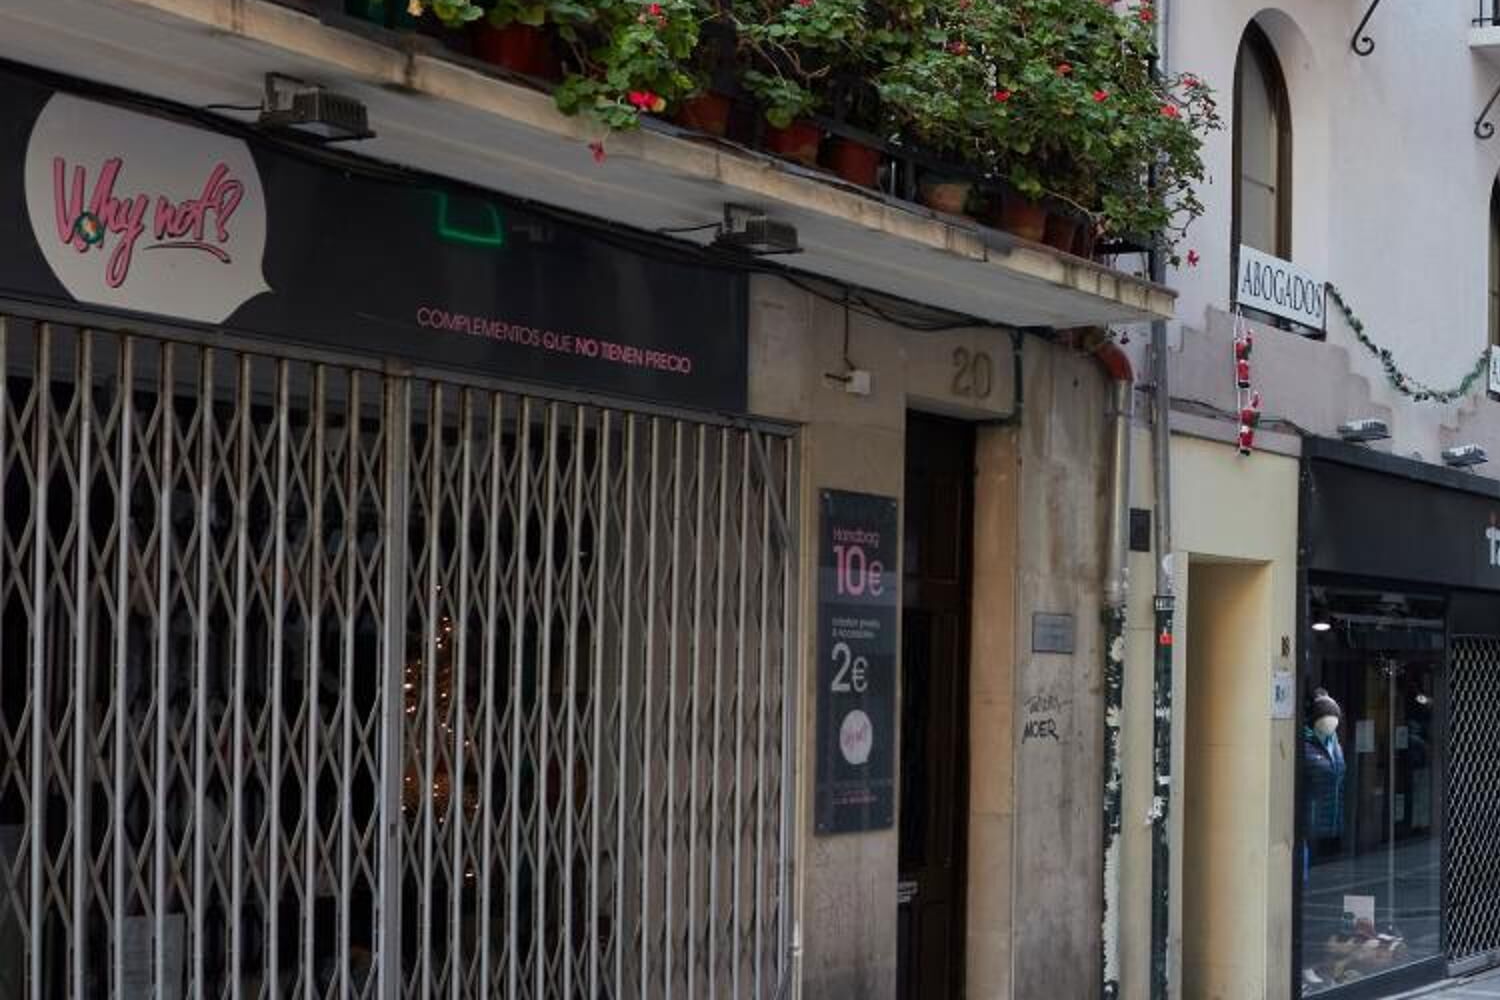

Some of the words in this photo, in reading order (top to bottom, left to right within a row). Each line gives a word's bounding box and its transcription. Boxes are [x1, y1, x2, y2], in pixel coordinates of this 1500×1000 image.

[53, 157, 149, 288] Why
[154, 163, 244, 243] not?
[1241, 260, 1322, 318] ABOGADOS
[416, 307, 541, 347] COMPLEMENTOS
[543, 330, 573, 353] QUE
[575, 336, 600, 358] NO
[601, 341, 643, 366] TIENEN
[645, 350, 692, 374] PRECIO
[951, 345, 992, 399] 20
[833, 545, 884, 596] 10€
[831, 642, 868, 692] 2€
